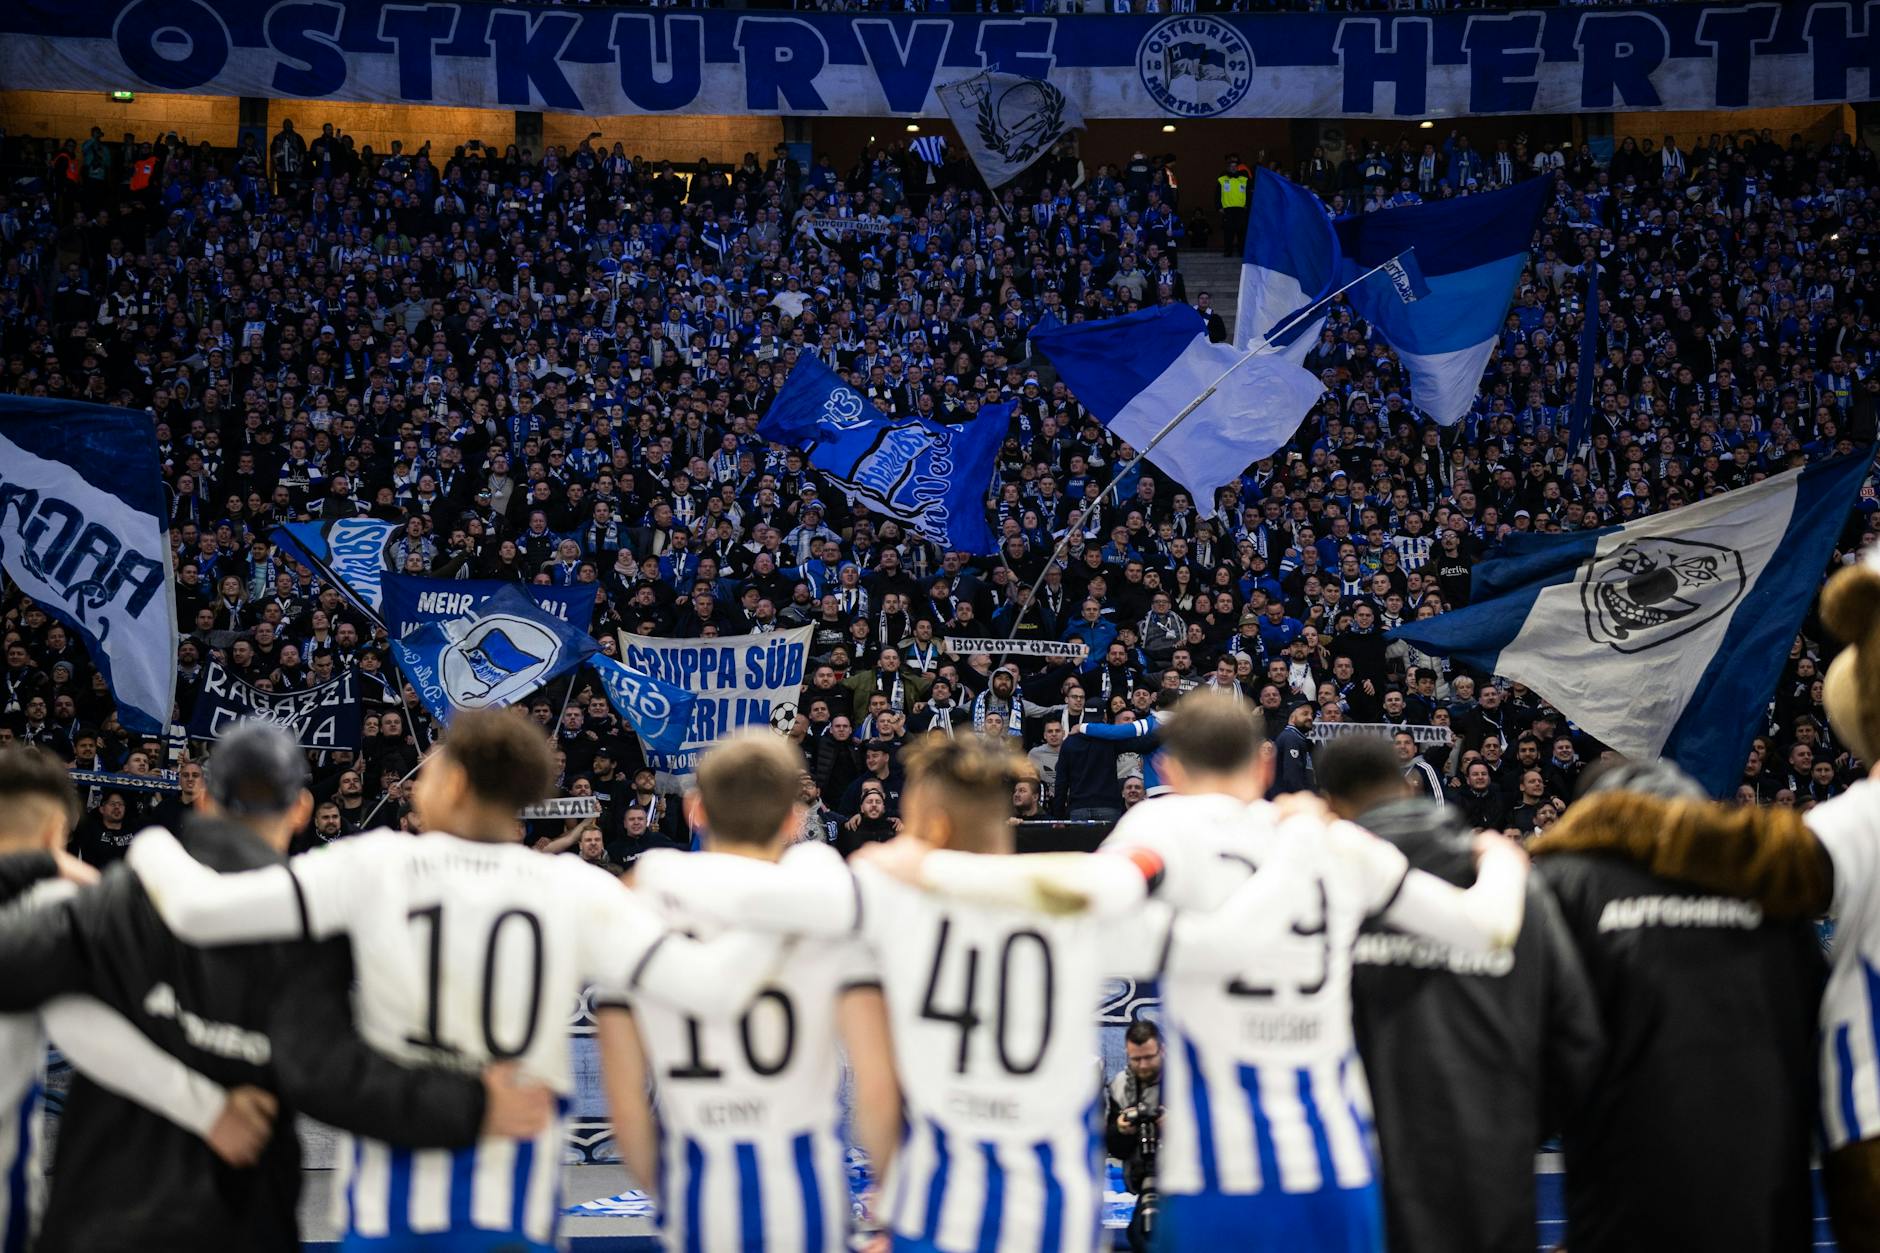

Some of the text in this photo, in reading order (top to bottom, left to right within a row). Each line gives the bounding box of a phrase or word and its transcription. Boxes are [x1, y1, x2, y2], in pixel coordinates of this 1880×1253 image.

[112, 0, 1057, 113] OSTKURVE
[1149, 20, 1243, 54] OSTKURVE
[1147, 60, 1246, 71] 18 92
[1147, 76, 1247, 114] HERTHA BSC
[417, 591, 474, 615] MEHR
[744, 637, 804, 690] SÜD
[952, 639, 1082, 656] BOYCOTT QATAR
[205, 661, 356, 716] RAGAZZI
[210, 705, 336, 746] CVA
[687, 698, 771, 743] ERLIN
[1309, 723, 1387, 739] BOYCOTT
[406, 904, 544, 1059] 10
[921, 916, 1055, 1076] 40
